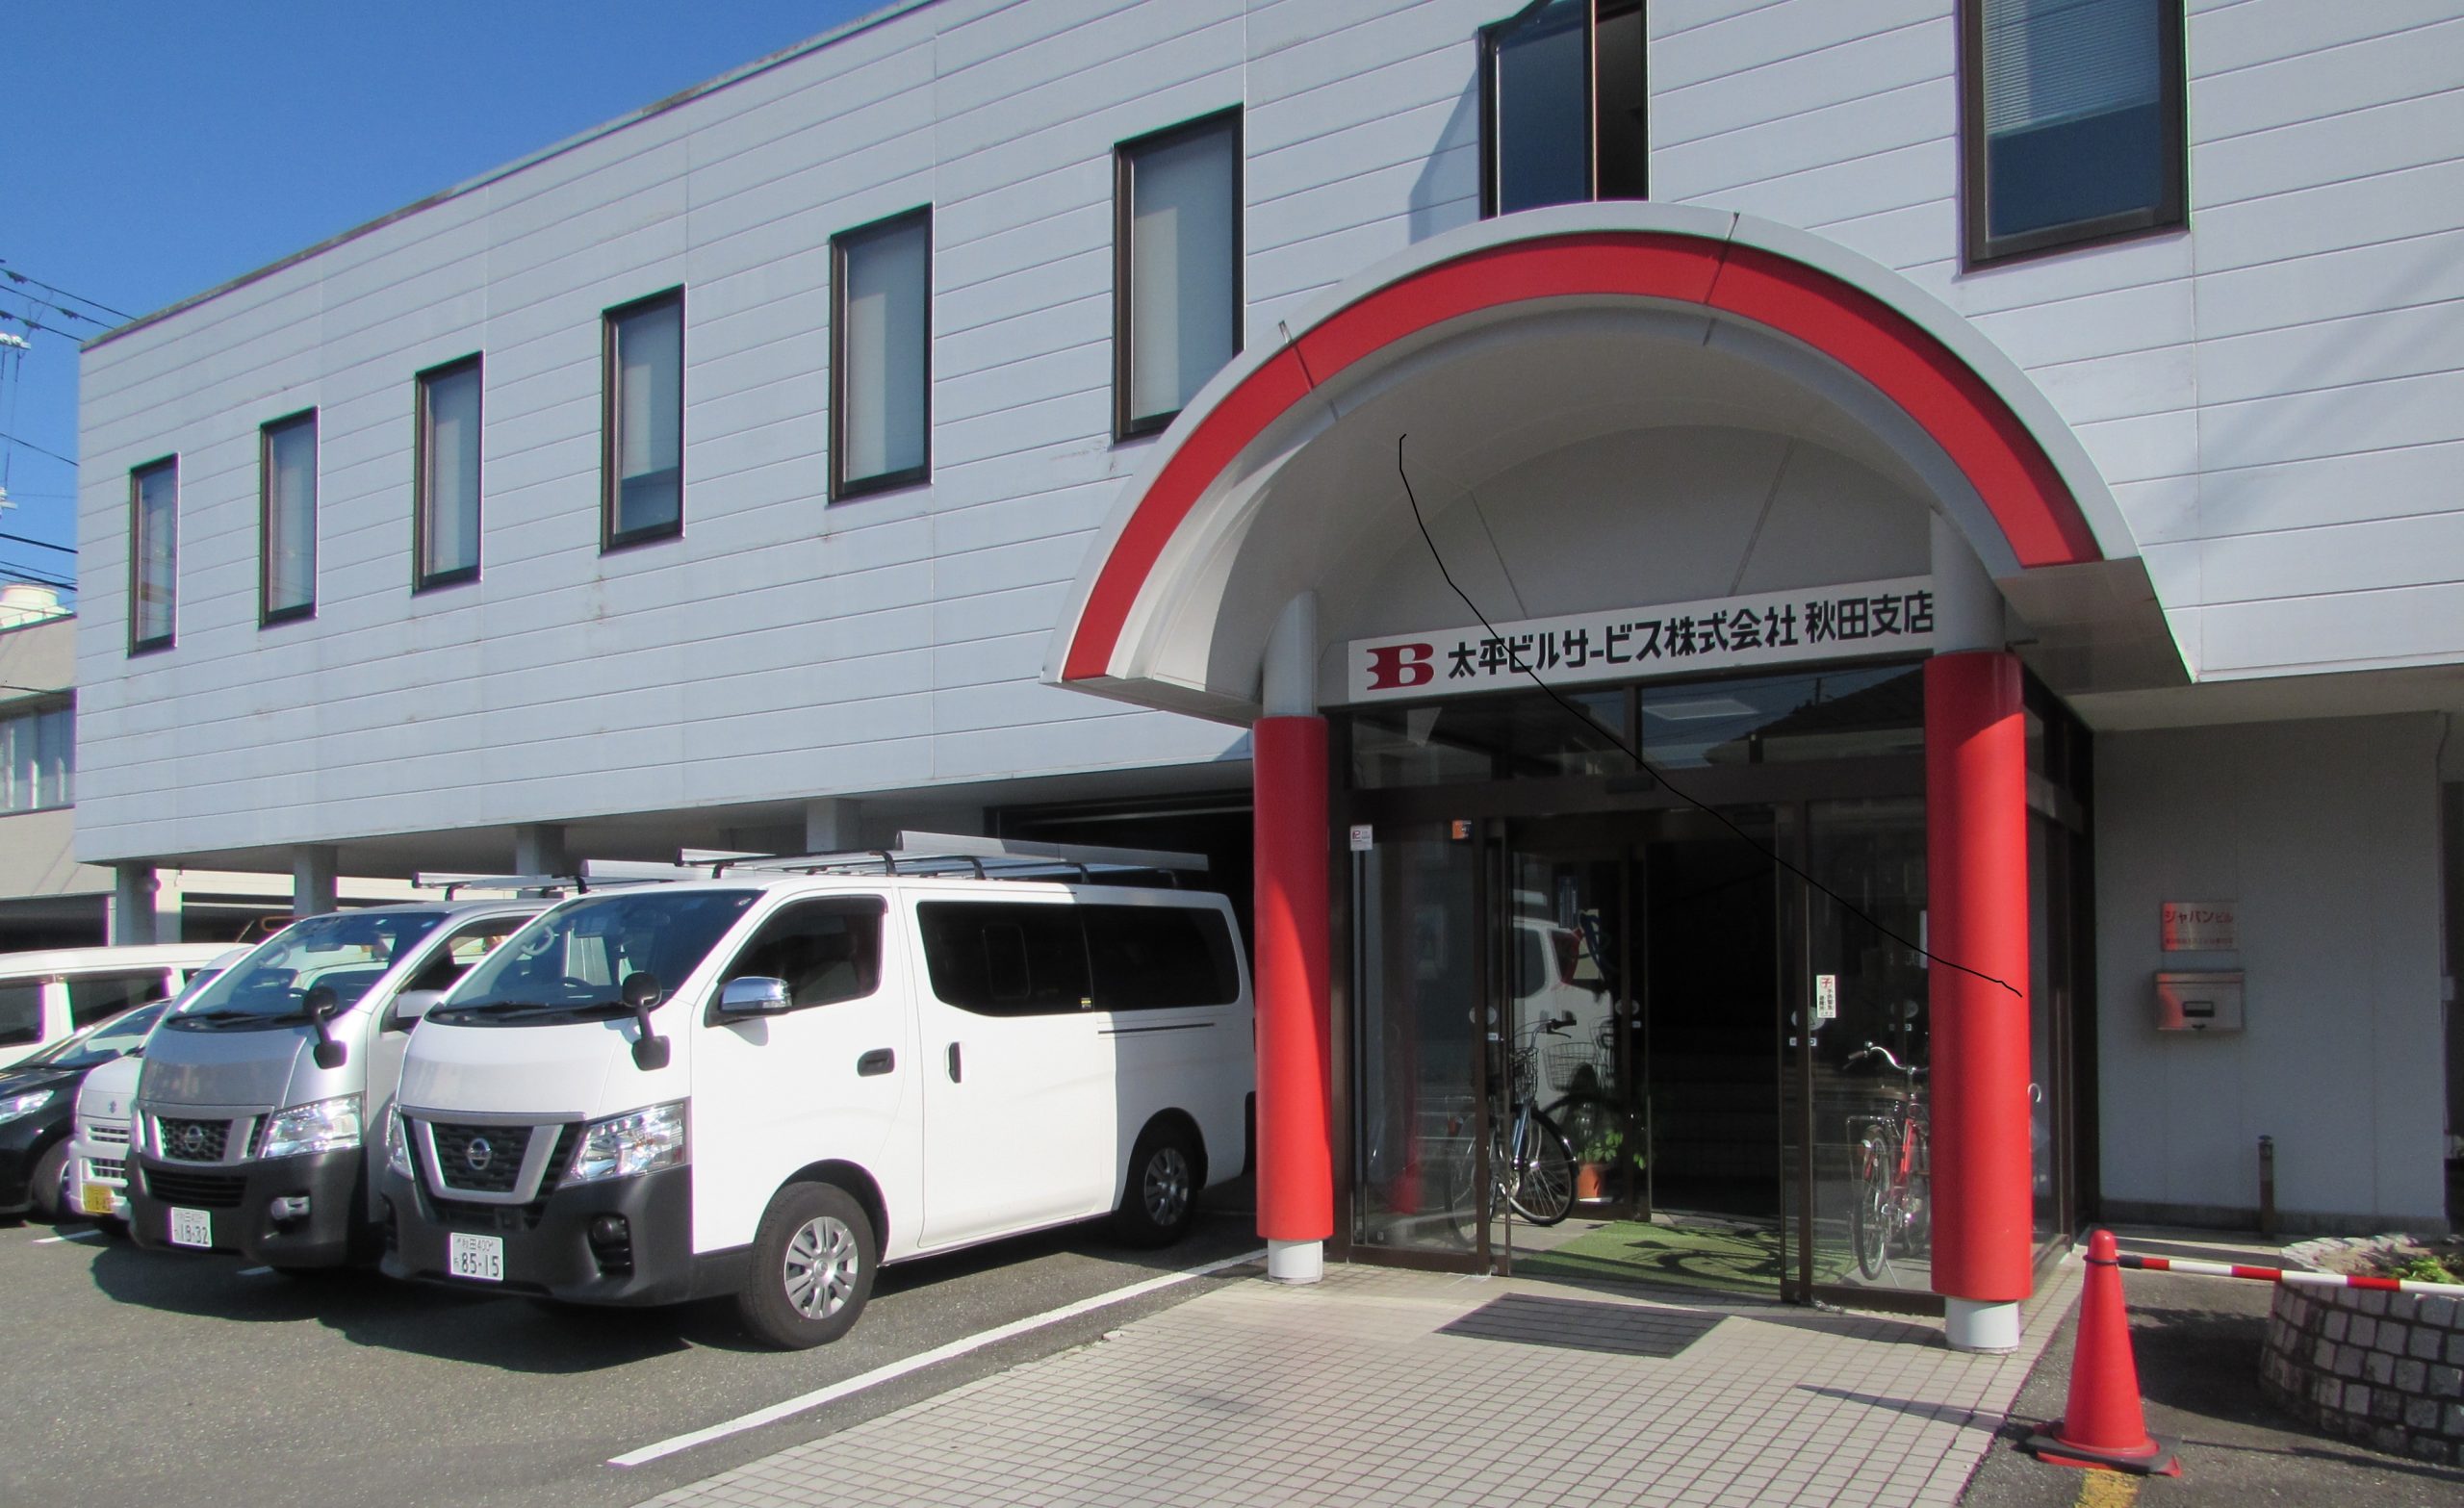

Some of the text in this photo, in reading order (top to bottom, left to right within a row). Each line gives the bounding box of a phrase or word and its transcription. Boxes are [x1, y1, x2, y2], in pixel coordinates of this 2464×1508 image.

[1447, 603, 1799, 679] 太平ビルサービス株式会社
[1805, 589, 1935, 644] 秋田支店
[2164, 909, 2234, 925] ジャパンビル
